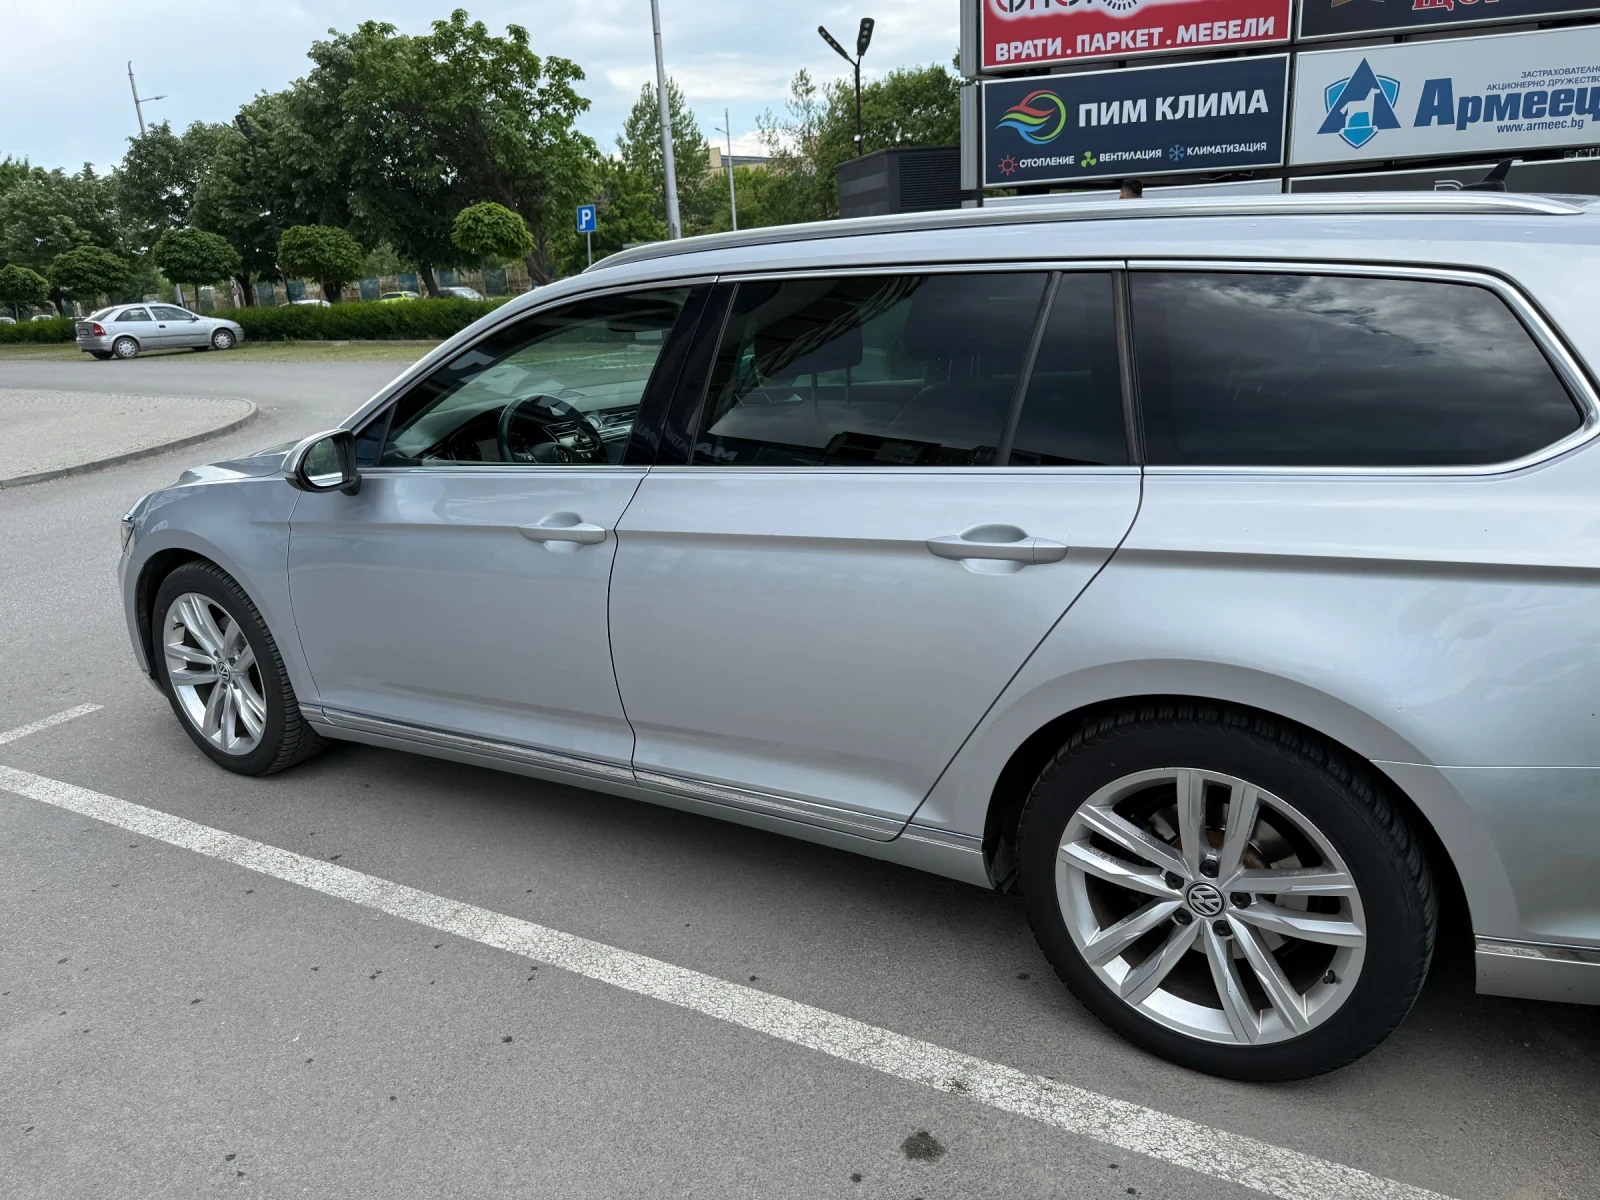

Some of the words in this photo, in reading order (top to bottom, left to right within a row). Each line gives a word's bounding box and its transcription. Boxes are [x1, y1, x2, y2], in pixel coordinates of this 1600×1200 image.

[995, 37, 1062, 62] ВРАТИ
[1076, 27, 1164, 54] ПАРКЕТ
[1176, 16, 1275, 44] МЕБЕЛИ
[1486, 80, 1546, 92] АКЦИОНЕРНО
[1079, 99, 1147, 127] ПИМ
[1155, 89, 1269, 121] КЛИМА
[1413, 77, 1600, 131] Армеец
[1496, 117, 1584, 133] www.armeec.bg
[1019, 155, 1075, 169] ОТОПЛЕНИЕ
[1099, 148, 1162, 163] ВЕНТИЛАЦИЯ
[1186, 141, 1267, 157] КЛИМАТИЗАЦИЯ
[580, 209, 592, 230] P
